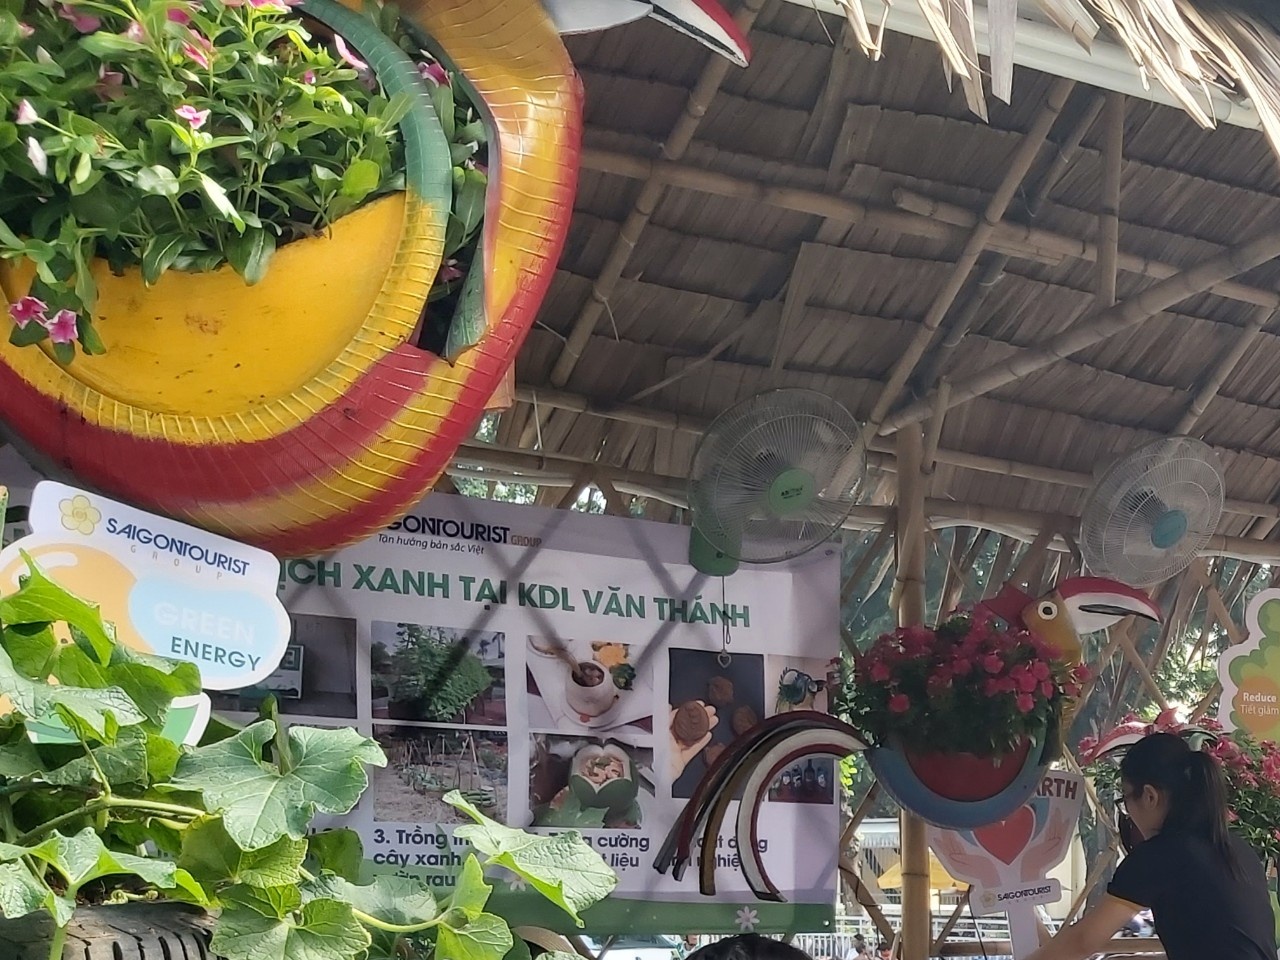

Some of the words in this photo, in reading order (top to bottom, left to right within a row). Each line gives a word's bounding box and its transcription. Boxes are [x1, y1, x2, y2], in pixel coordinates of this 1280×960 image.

[106, 518, 250, 576] SAIGONTOURIST
[511, 534, 542, 547] GROUP
[130, 544, 223, 581] GROUP
[352, 563, 449, 599] XANH
[459, 575, 507, 611] TẠI
[518, 582, 575, 612] KDL
[582, 585, 646, 619] VĂN
[653, 595, 749, 628] THÁNH
[154, 601, 256, 646] GREEN
[171, 636, 262, 672] ENERGY
[1243, 692, 1277, 703] Reduce
[1035, 776, 1078, 800] RTH
[374, 829, 391, 844] 3.
[395, 825, 448, 849] Trồng
[597, 832, 650, 852] cường
[373, 850, 411, 868] cây
[426, 875, 455, 887] rau
[997, 886, 1052, 901] SAIGONTOURIST
